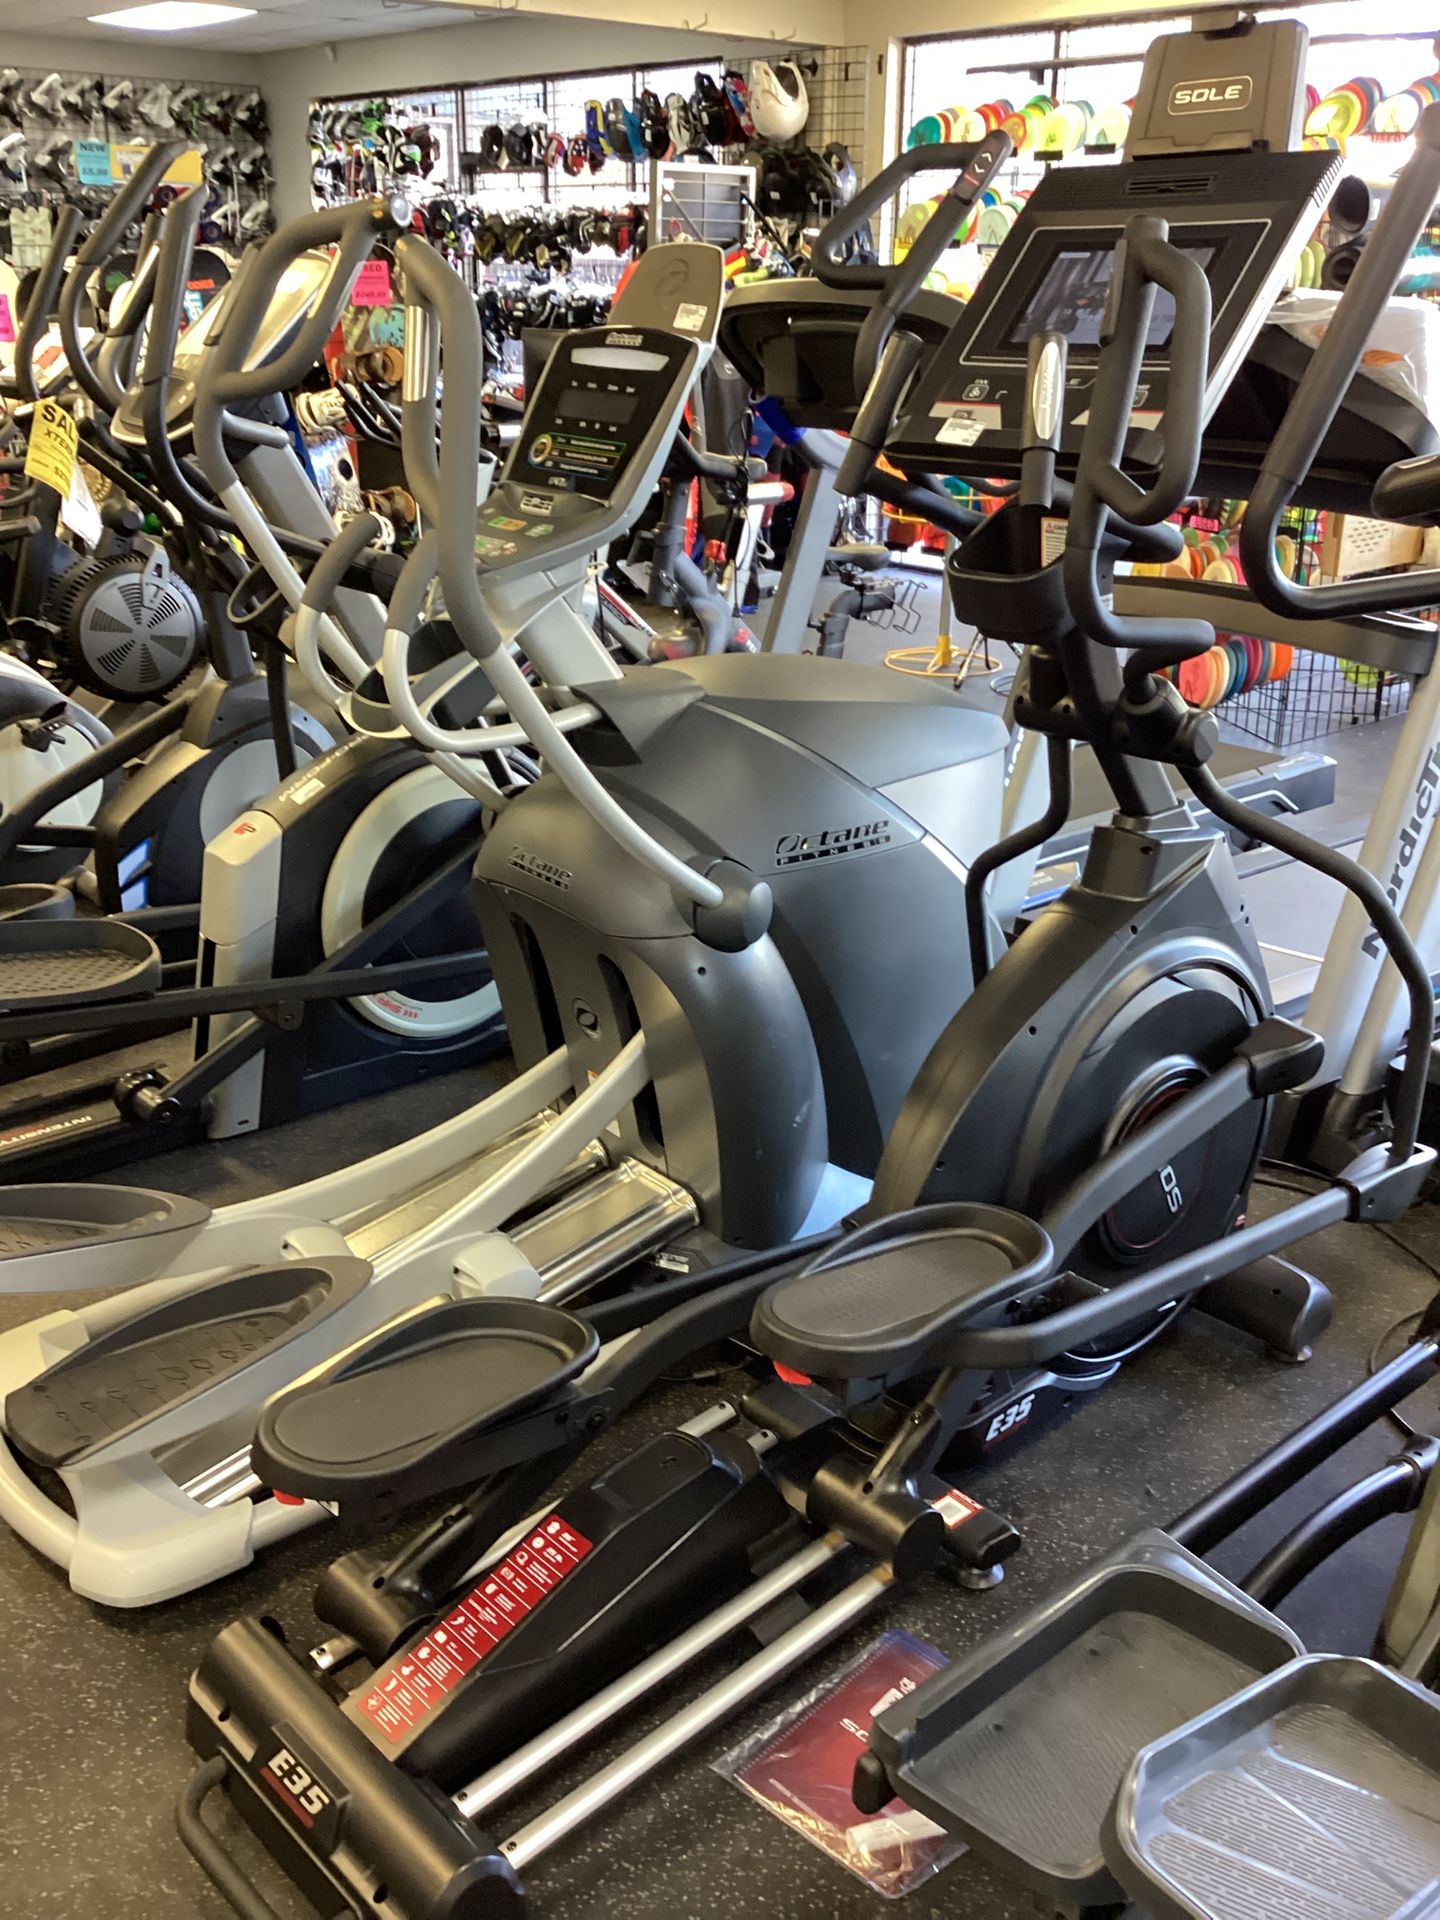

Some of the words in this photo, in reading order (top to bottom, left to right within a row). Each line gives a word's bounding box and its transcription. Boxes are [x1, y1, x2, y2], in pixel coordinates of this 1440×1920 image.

[1174, 84, 1243, 105] SOLE
[80, 142, 105, 152] NEW
[42, 404, 75, 442] SAL
[775, 820, 889, 855] Octane
[1159, 1165, 1183, 1213] SO
[985, 1393, 1036, 1442] E35
[839, 1717, 870, 1743] SO
[267, 1748, 331, 1815] E35
